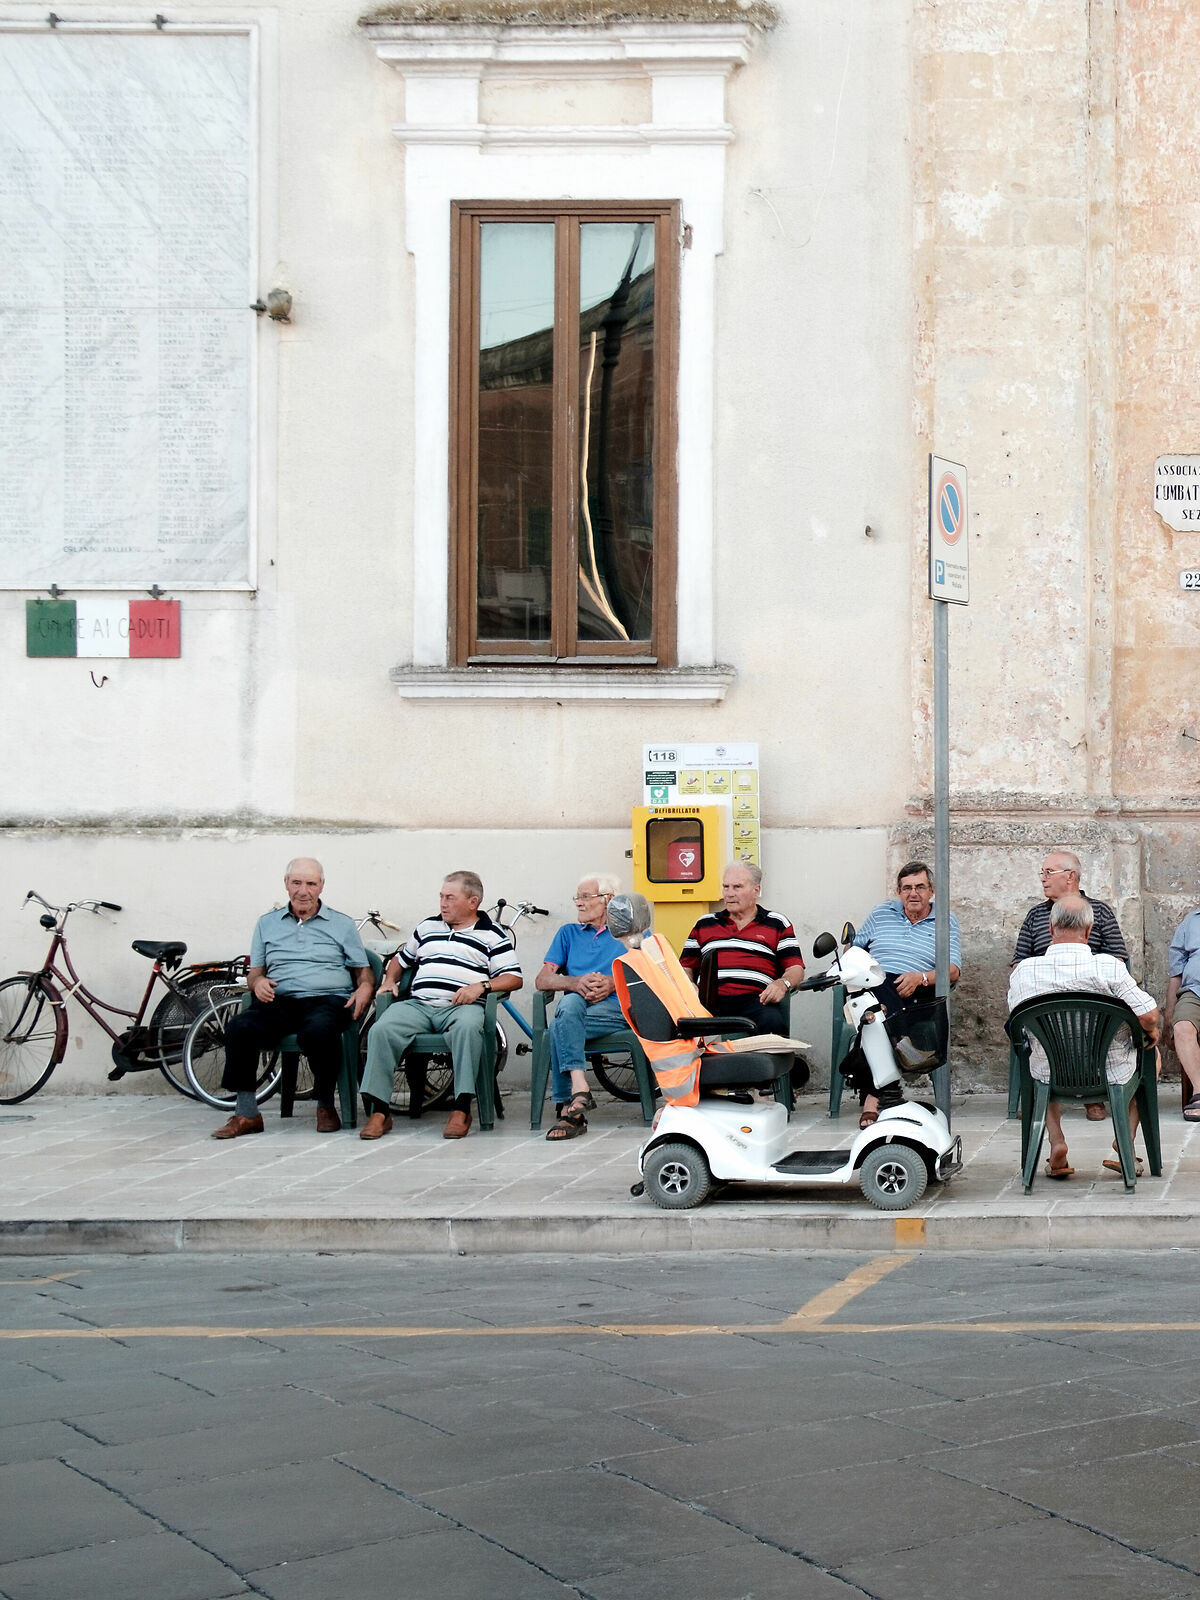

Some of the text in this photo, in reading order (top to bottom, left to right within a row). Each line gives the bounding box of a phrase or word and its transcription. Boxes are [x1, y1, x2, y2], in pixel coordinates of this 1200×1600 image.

[93, 617, 110, 639] AI
[118, 617, 170, 639] CADUTI
[652, 752, 676, 761] 118
